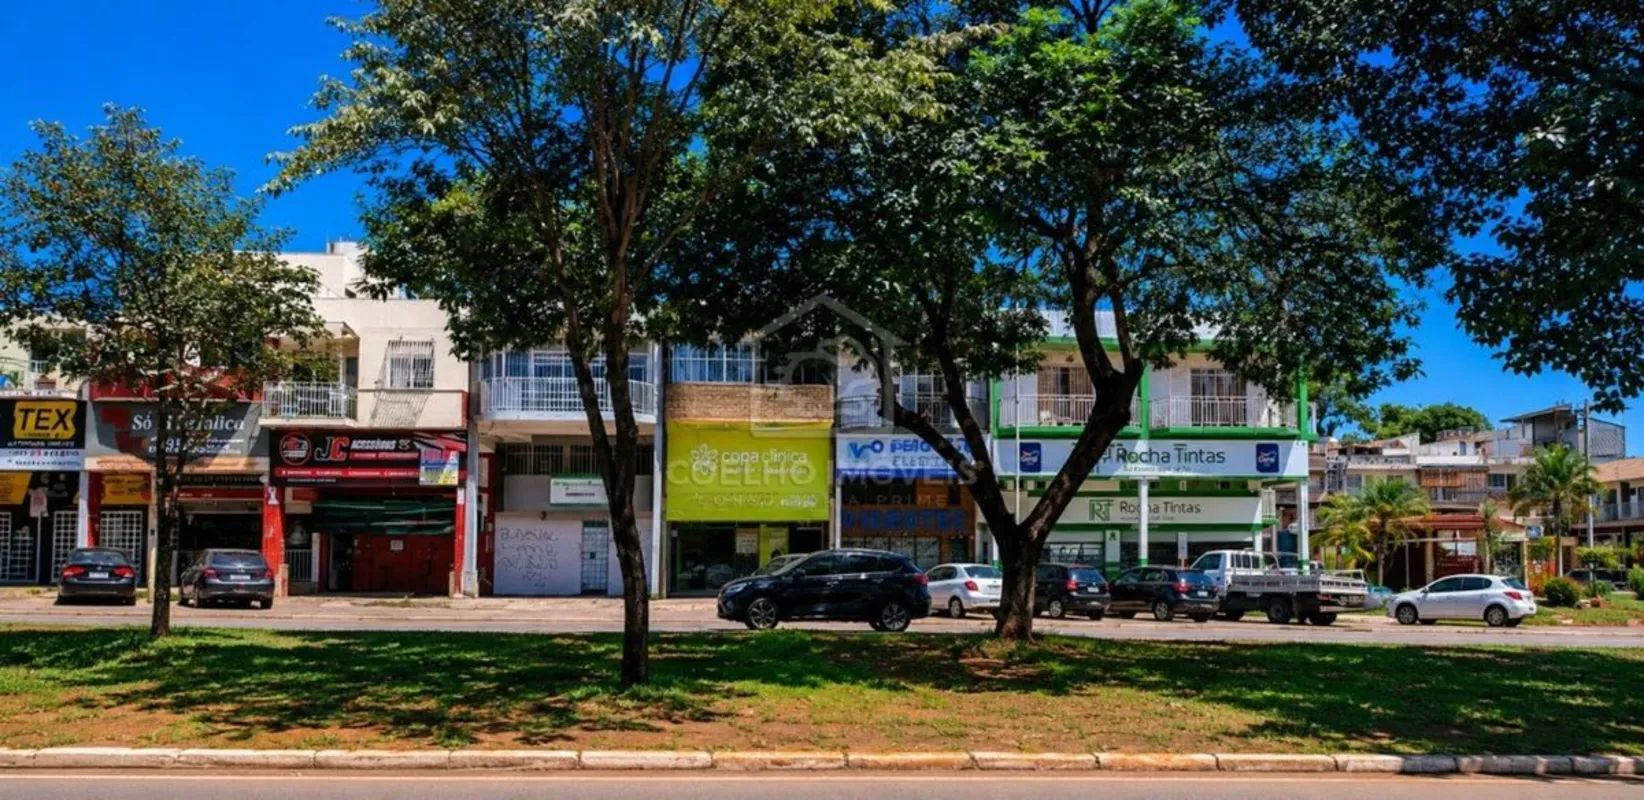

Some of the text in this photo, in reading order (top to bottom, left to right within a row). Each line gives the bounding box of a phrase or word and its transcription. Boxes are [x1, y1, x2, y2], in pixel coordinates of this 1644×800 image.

[18, 408, 72, 431] TEX
[314, 436, 349, 462] JC
[721, 451, 760, 464] copa
[1116, 444, 1226, 464] Rocha Tintas
[1163, 500, 1201, 514] Tintas
